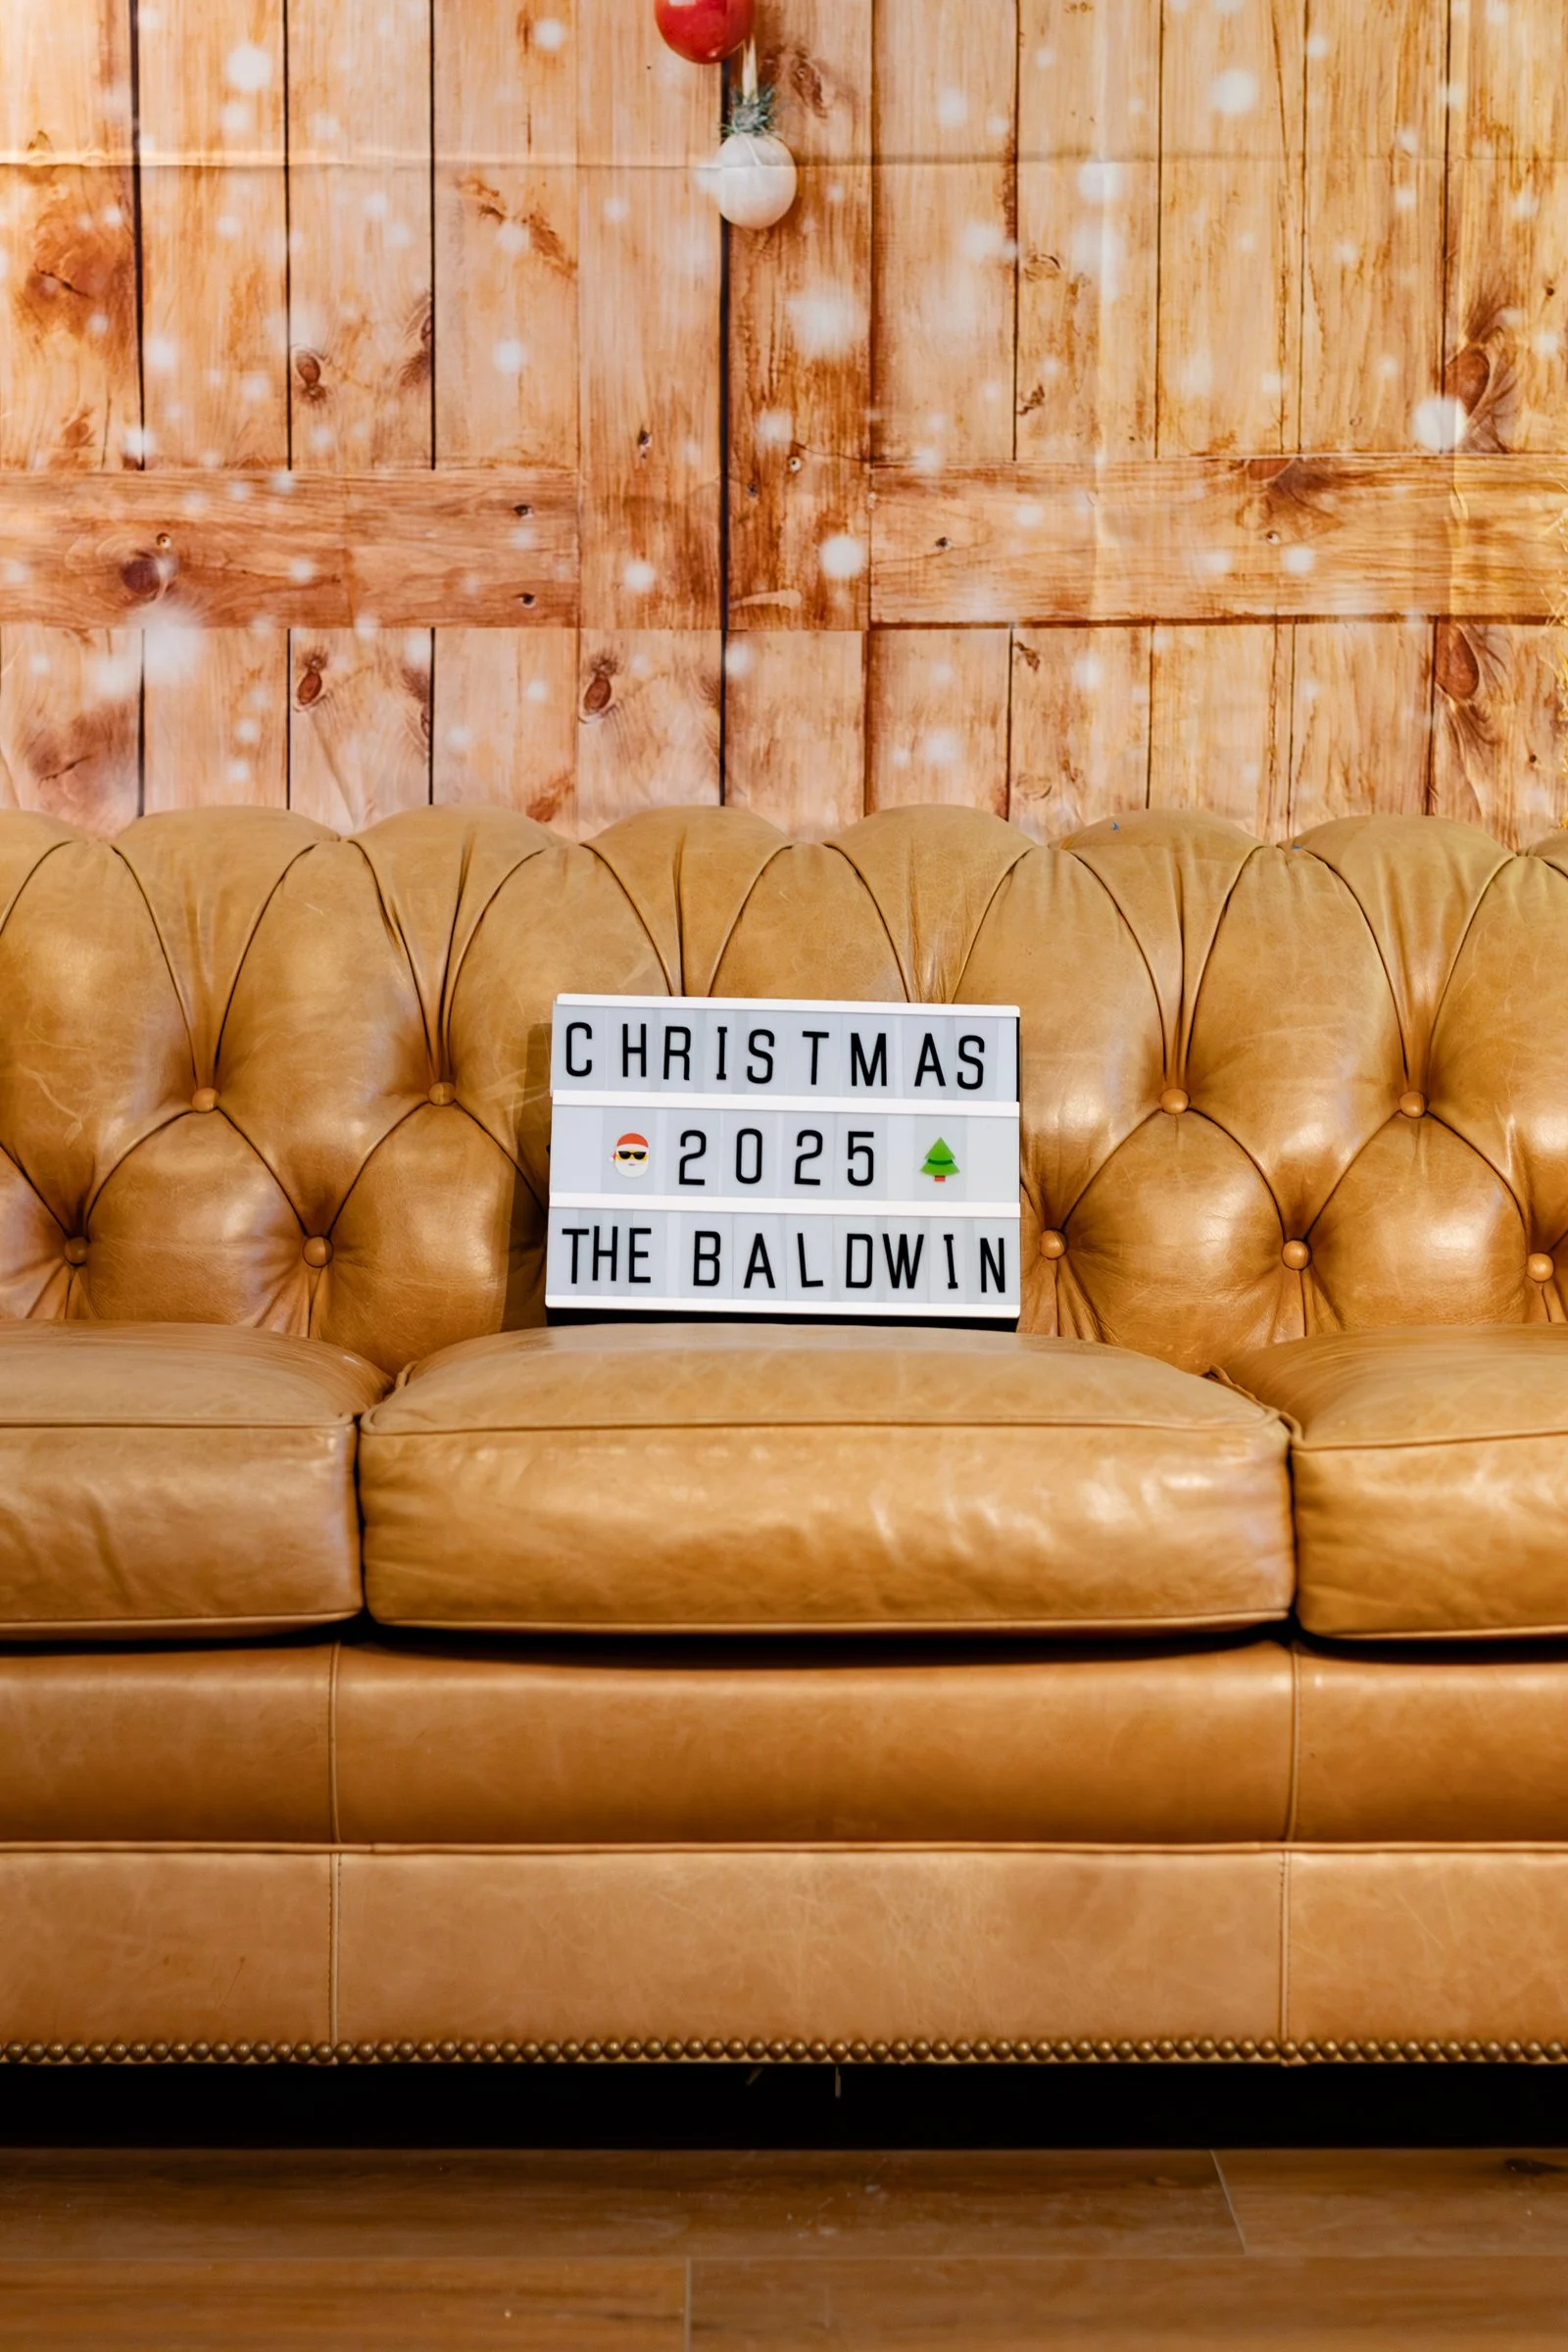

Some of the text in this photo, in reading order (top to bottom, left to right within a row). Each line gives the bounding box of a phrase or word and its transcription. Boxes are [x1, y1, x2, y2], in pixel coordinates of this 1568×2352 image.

[565, 1021, 985, 1090] CHRISTMAS
[678, 1128, 874, 1187] 2025
[562, 1226, 1006, 1294] THE BALDWIN
